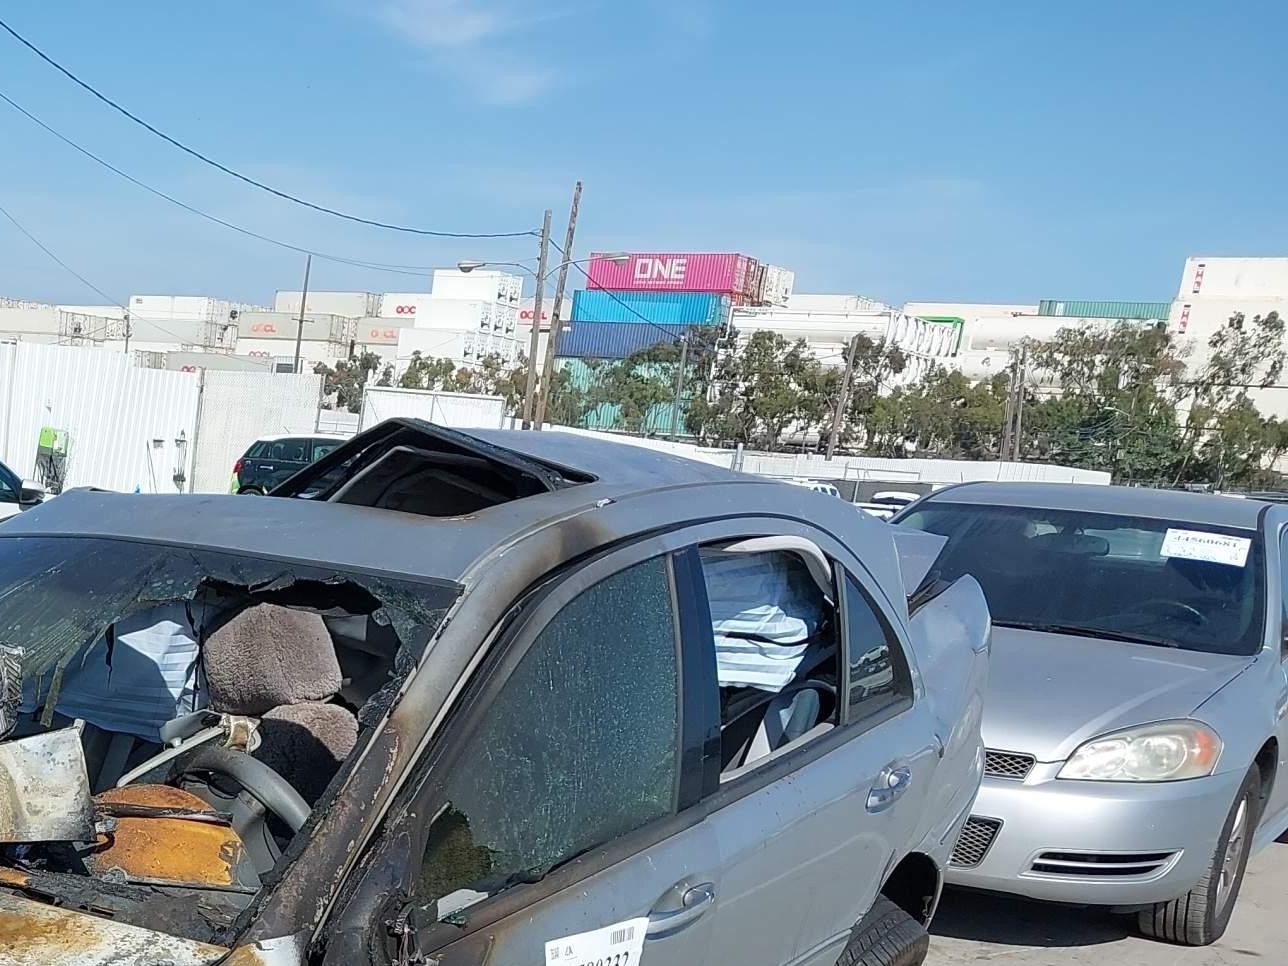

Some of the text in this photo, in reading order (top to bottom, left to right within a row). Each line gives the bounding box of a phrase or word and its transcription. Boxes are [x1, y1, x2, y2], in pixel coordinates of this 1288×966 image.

[634, 258, 688, 279] ONE
[396, 306, 416, 314] OOC
[520, 311, 548, 320] OOL
[371, 330, 397, 339] OCL
